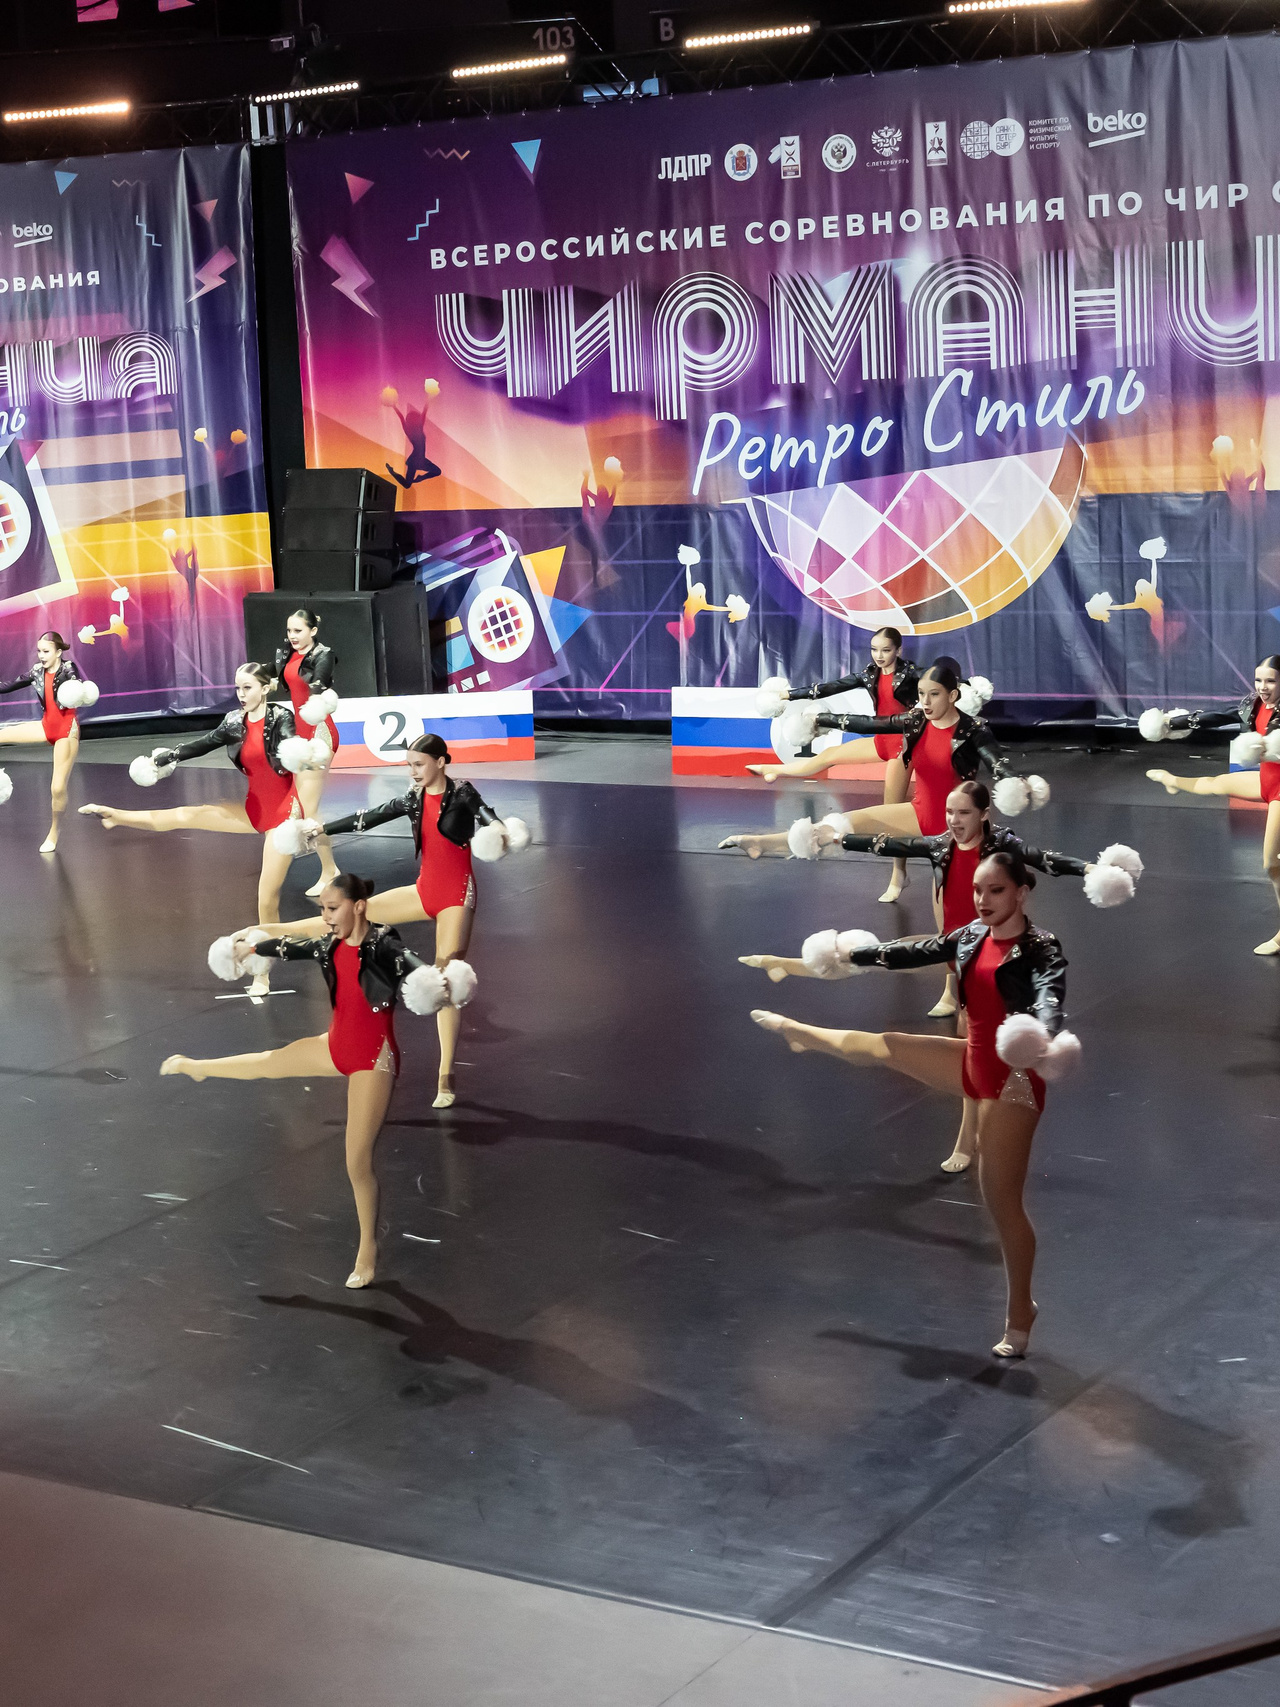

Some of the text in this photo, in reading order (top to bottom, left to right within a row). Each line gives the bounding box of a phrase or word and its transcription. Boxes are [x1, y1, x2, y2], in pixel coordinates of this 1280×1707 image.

[532, 26, 575, 50] 103
[1028, 116, 1070, 127] КОМИТЕТ ПО
[1028, 124, 1072, 135] ФИЗИЧЕСКОЙ
[1087, 110, 1147, 133] beko
[1029, 134, 1059, 142] КУЛЬТУРЕ
[1036, 141, 1061, 150] СПОРТУ
[658, 153, 712, 182] ЛДПР
[12, 222, 53, 239] beko
[430, 224, 727, 270] ВСЕРОССИЙСКИЕ
[744, 197, 1065, 245] СОРЕВНОВАНИЯ
[1088, 191, 1143, 218] ПО
[1164, 183, 1249, 211] ЧИР
[691, 368, 1145, 496] Ретро Стиль
[378, 711, 408, 752] 2
